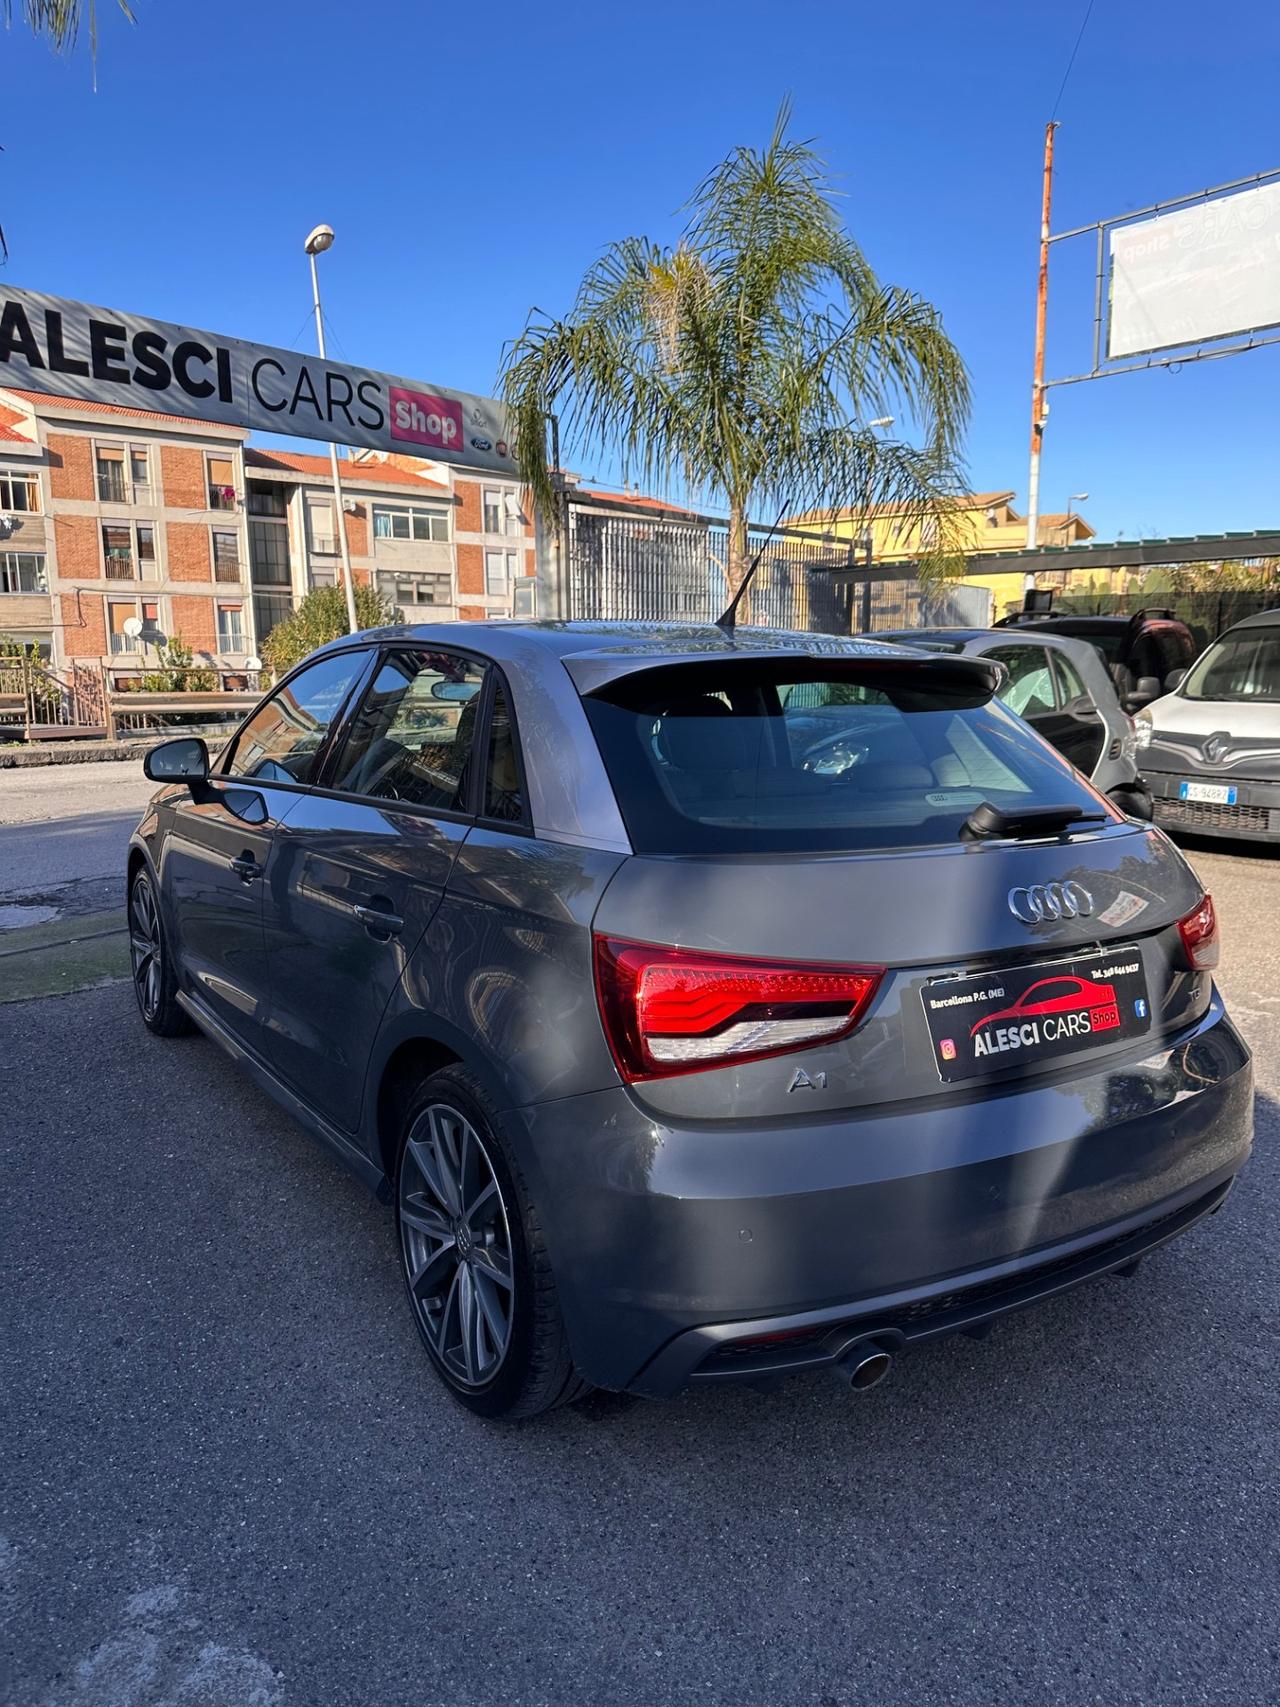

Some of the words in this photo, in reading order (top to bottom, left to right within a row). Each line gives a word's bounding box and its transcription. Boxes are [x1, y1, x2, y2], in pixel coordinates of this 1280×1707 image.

[0, 301, 233, 404] ALESCI
[252, 358, 385, 431] CARS
[395, 401, 457, 444] Shop
[930, 995, 974, 1009] Barcellona
[973, 992, 988, 1002] P.G.
[988, 987, 1005, 999] (ME)
[974, 1023, 1040, 1057] ALESCI
[1042, 1011, 1091, 1041] CARS
[1092, 1010, 1117, 1025] Shop
[786, 1067, 828, 1093] A1
